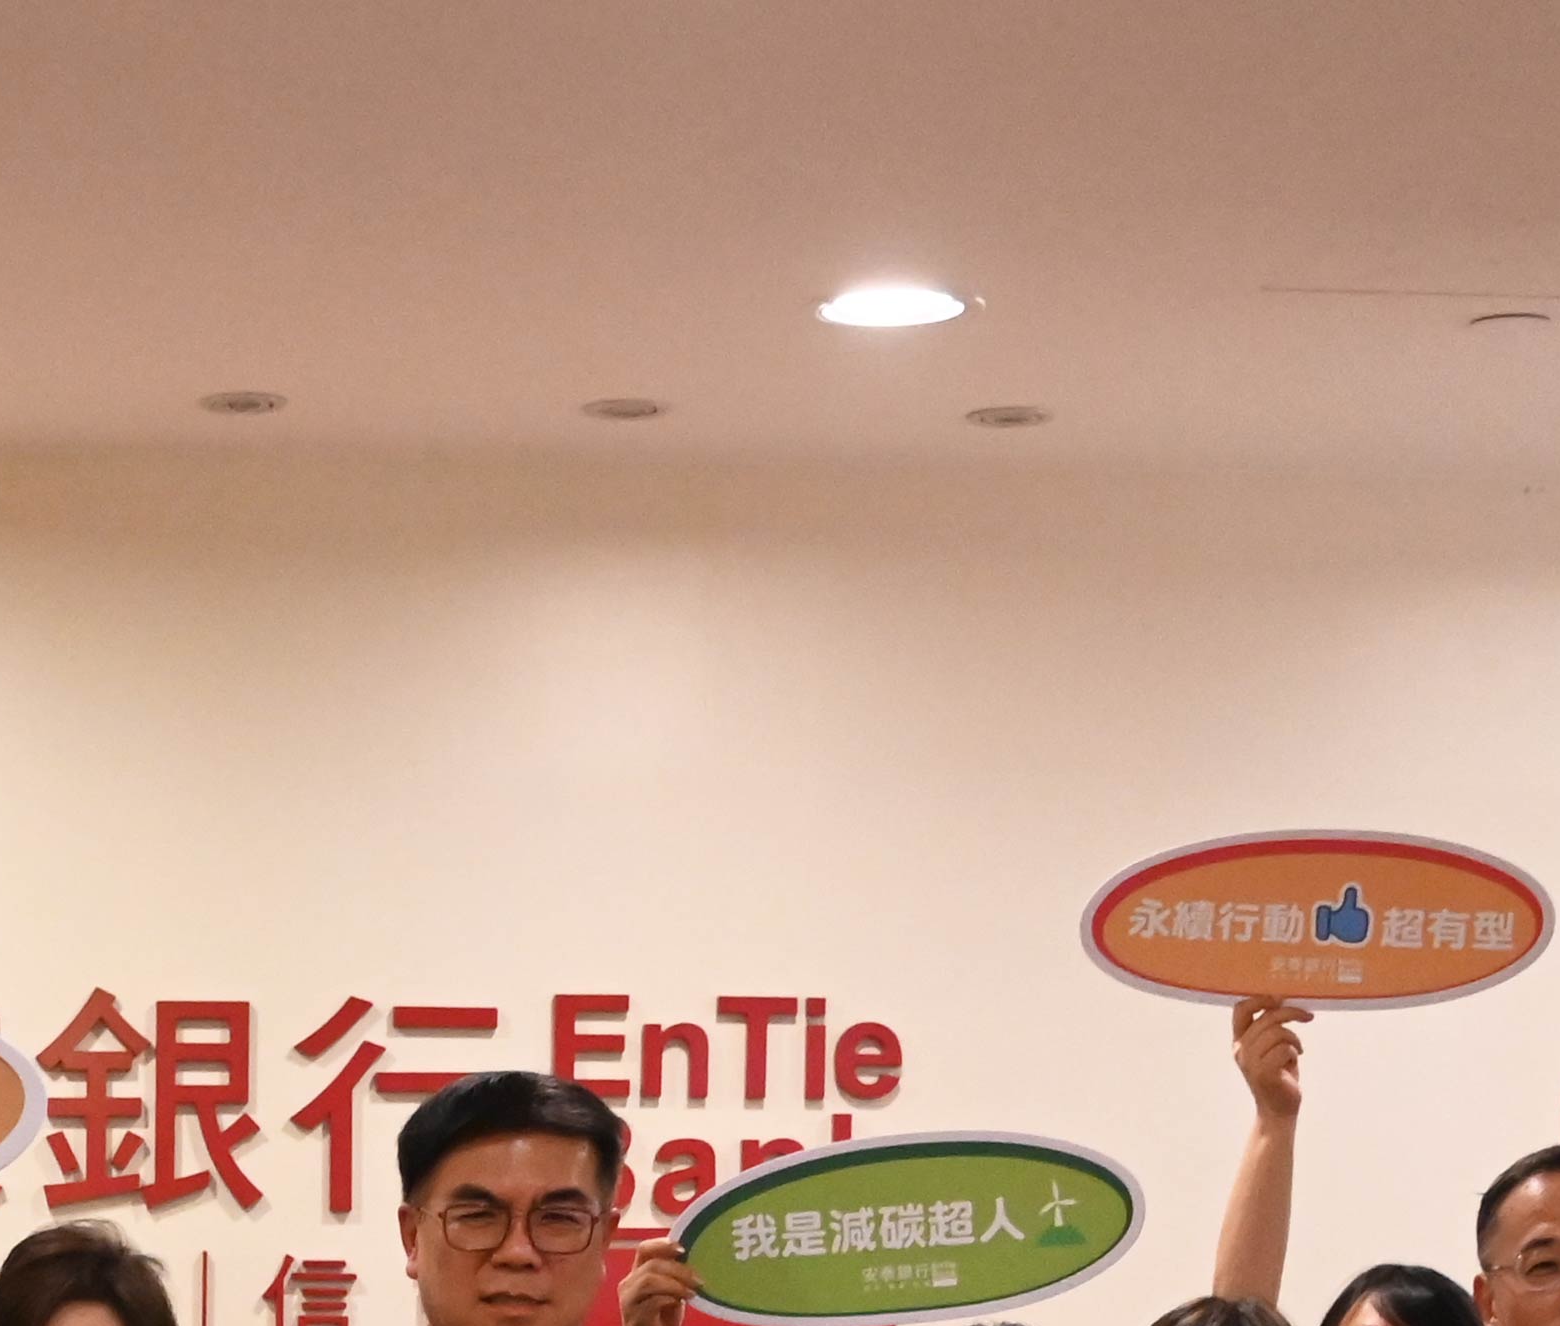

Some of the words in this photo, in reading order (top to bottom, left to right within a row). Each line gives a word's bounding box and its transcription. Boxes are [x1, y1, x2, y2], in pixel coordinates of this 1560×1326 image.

[1128, 898, 1305, 945] 永續行動
[1381, 907, 1515, 951] 超有型
[554, 995, 902, 1100] EnTie
[732, 1196, 1026, 1261] 我是減碳超人
